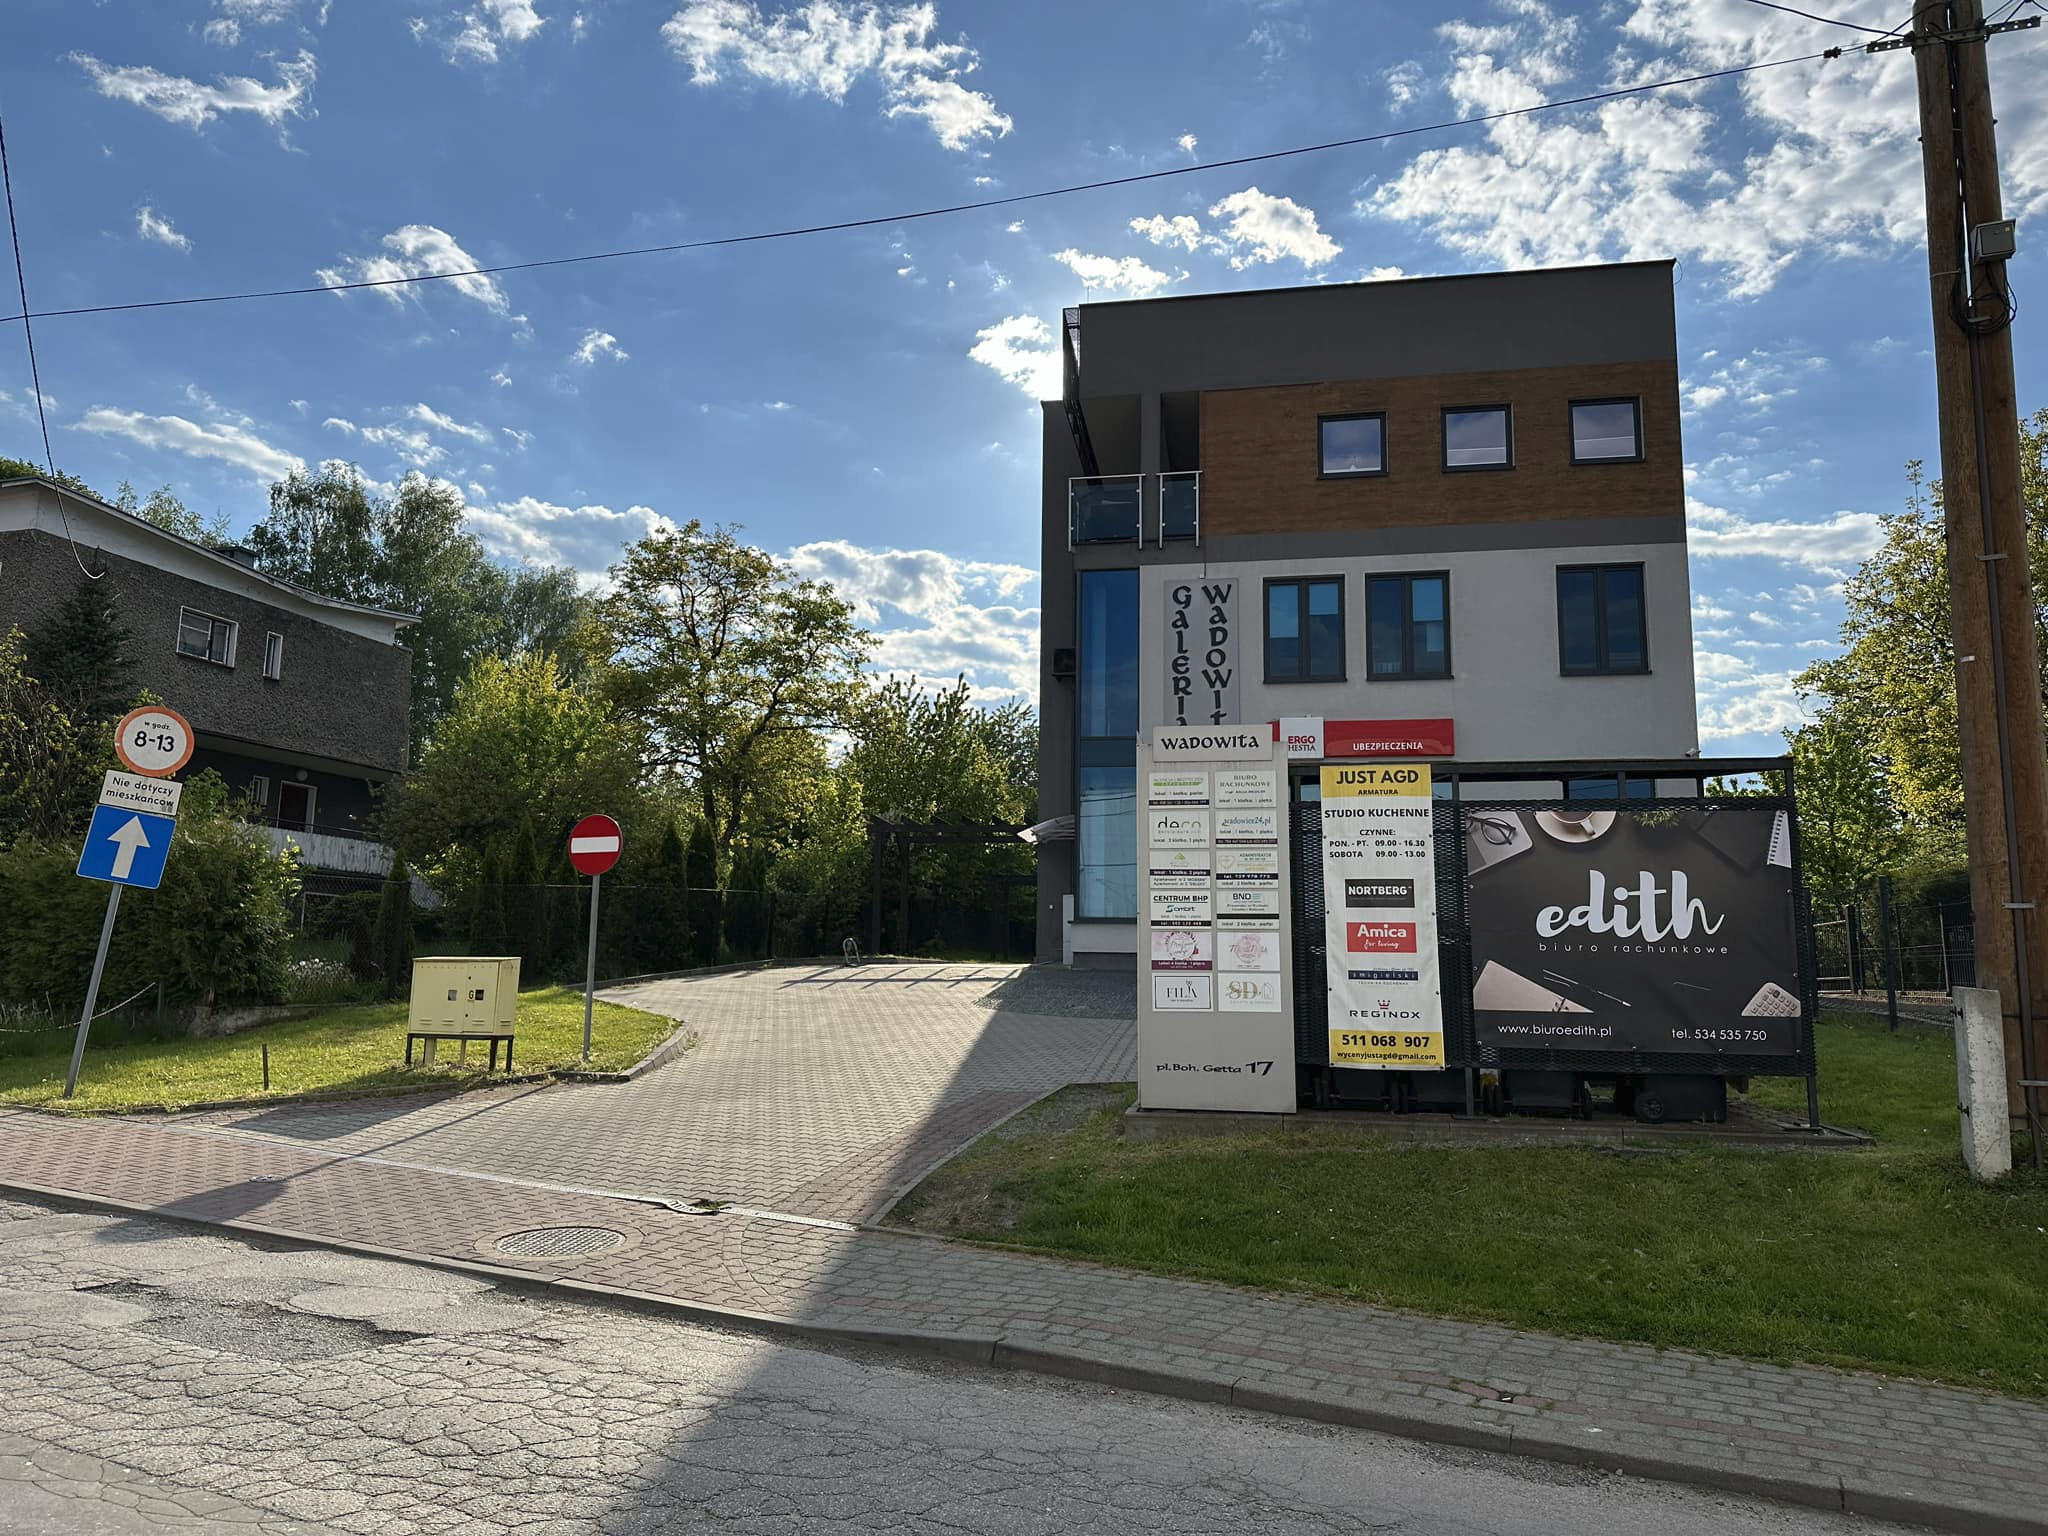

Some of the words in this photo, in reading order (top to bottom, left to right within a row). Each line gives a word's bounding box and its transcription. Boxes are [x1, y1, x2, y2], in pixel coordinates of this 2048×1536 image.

[134, 730, 174, 752] 8-13
[1288, 736, 1316, 744] ERGO
[1352, 742, 1424, 752] UBEZPIECZENIA
[1336, 770, 1376, 784] JUST
[1381, 770, 1419, 784] AGD
[112, 776, 130, 788] Nie
[134, 780, 174, 797] dotyczy
[1324, 808, 1366, 818] STUDIO
[1368, 808, 1430, 818] KUCHENNE
[1359, 828, 1397, 836] CZYNNE:
[1348, 886, 1408, 896] NORTBERG
[1535, 869, 1726, 943] edith
[1358, 924, 1407, 938] Amica
[1538, 942, 1598, 952] biuro
[1612, 944, 1728, 954] rachunkowe
[468, 990, 475, 1000] G
[1349, 1010, 1421, 1019] REGINOX
[1498, 1022, 1613, 1038] www.biuroedith.pl
[1672, 1028, 1692, 1040] tel.
[1694, 1028, 1716, 1040] 534
[1719, 1029, 1742, 1040] 535
[1744, 1030, 1768, 1041] 750
[1342, 1034, 1366, 1046] 511
[1370, 1035, 1397, 1047] 068
[1404, 1036, 1430, 1048] 907
[1336, 1050, 1437, 1061] wycenyjustagd@gmail.com
[1202, 1064, 1242, 1074] Getta
[1246, 1060, 1274, 1077] 17
